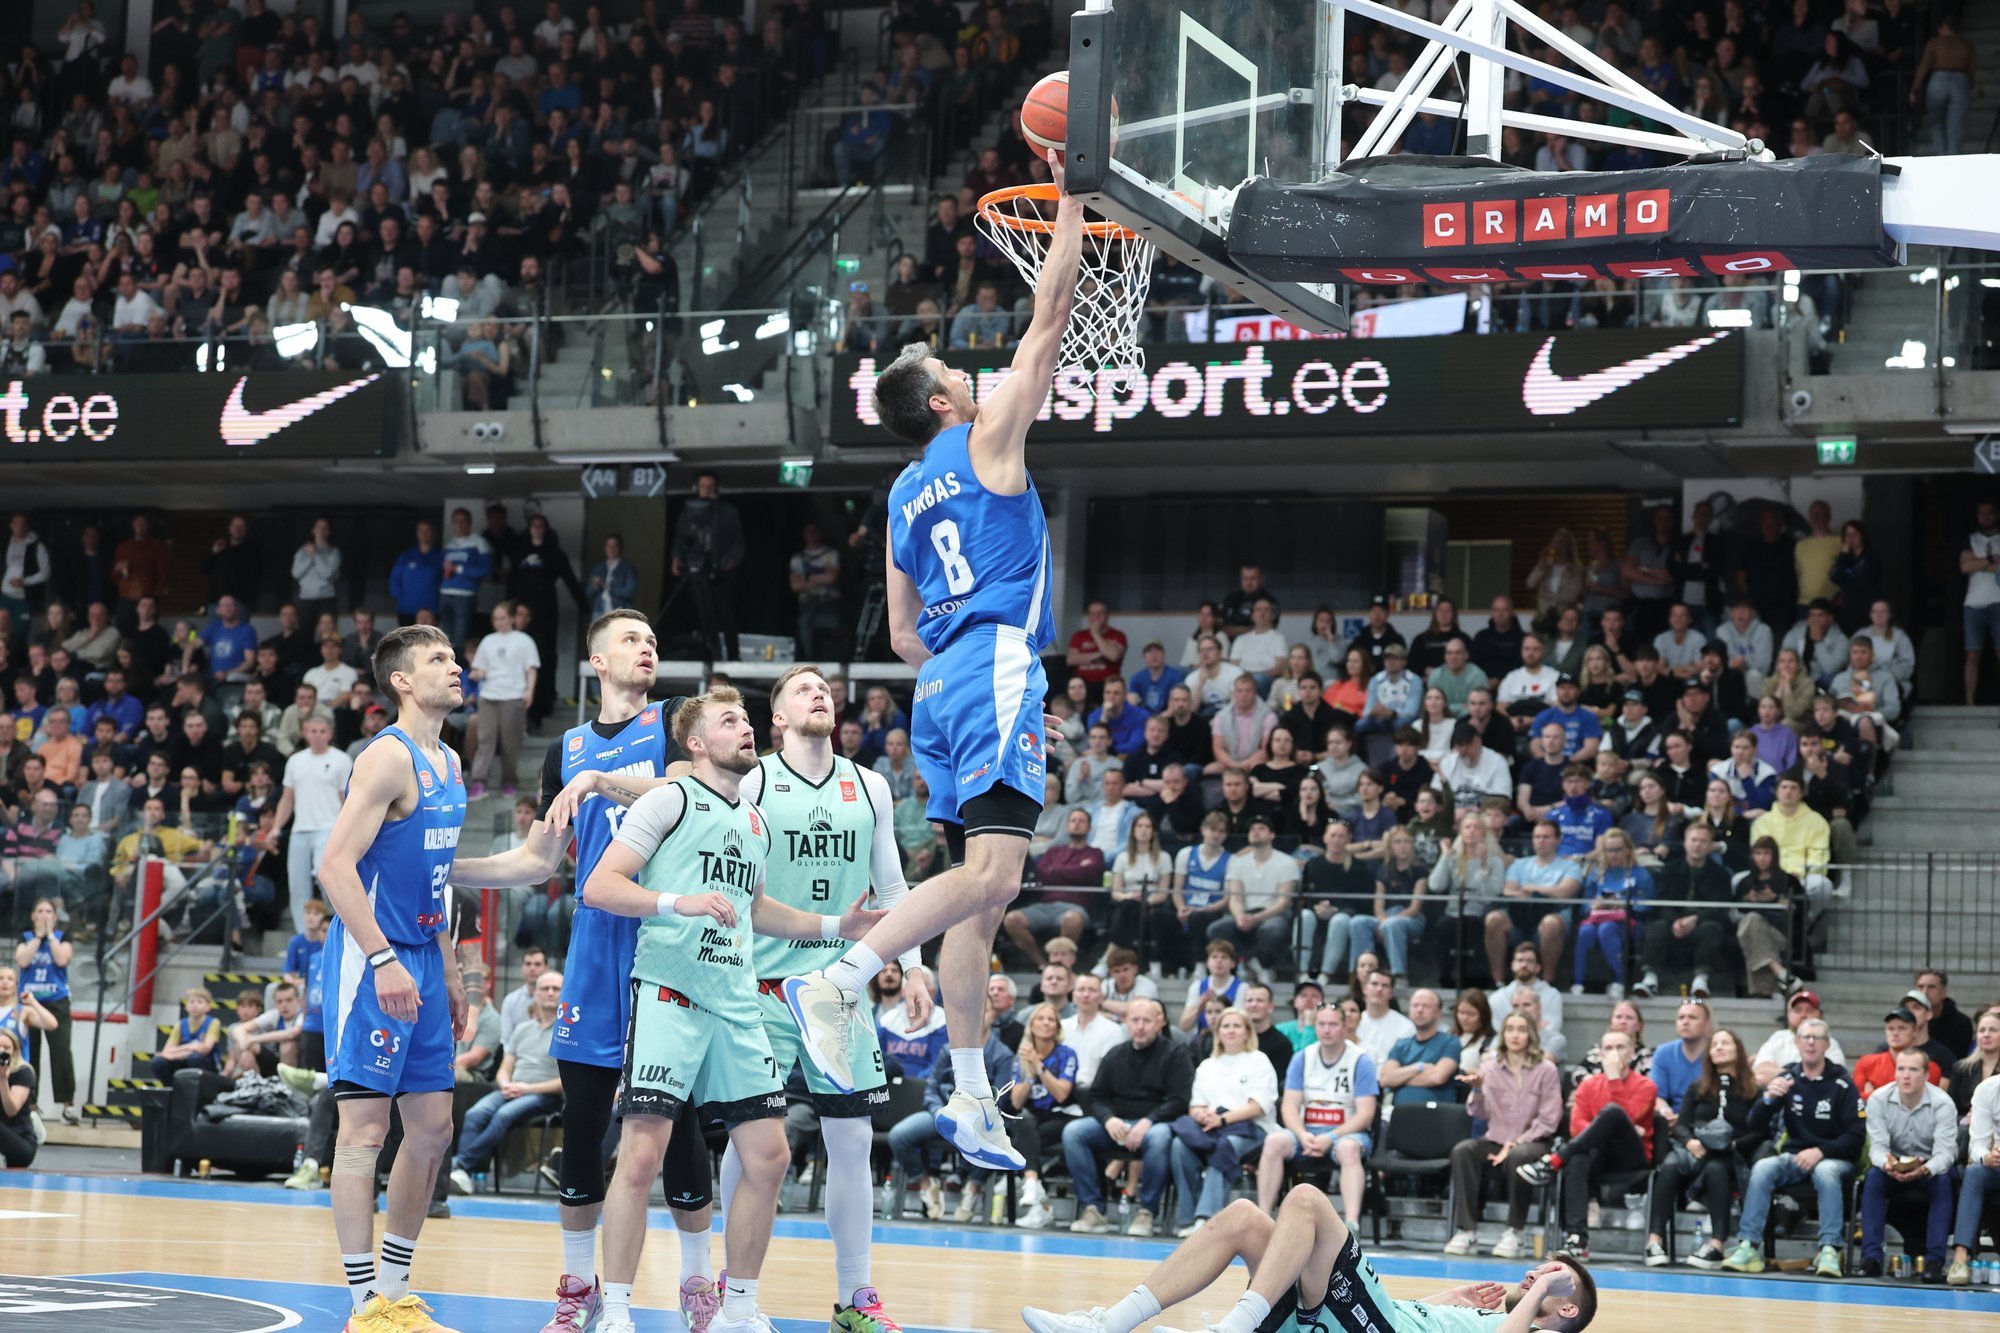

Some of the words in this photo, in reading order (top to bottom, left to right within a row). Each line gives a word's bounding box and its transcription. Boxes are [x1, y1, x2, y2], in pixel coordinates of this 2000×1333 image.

[1433, 200, 1658, 238] CRAMO
[849, 345, 1390, 432] tsport.ee
[591, 468, 617, 487] A4
[930, 518, 975, 596] 8
[783, 830, 856, 863] TARTU
[697, 850, 757, 897] TARTU
[812, 878, 830, 901] 9
[700, 927, 733, 948] Maks
[697, 946, 744, 967] Moorits
[637, 1064, 672, 1084] LUX
[764, 1056, 776, 1079] 7
[1334, 1076, 1350, 1093] 14
